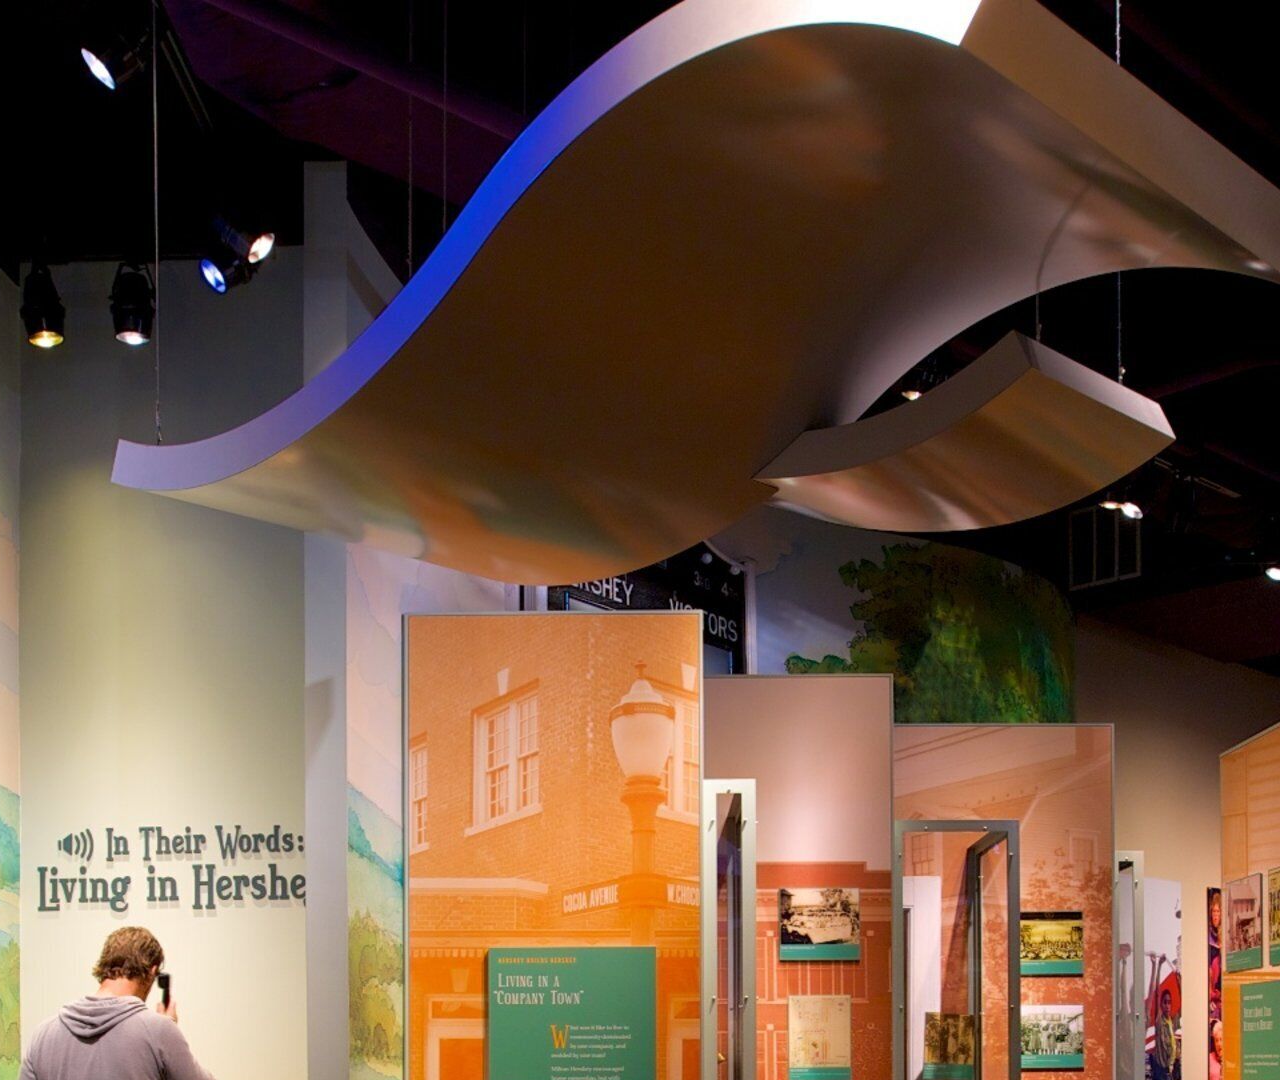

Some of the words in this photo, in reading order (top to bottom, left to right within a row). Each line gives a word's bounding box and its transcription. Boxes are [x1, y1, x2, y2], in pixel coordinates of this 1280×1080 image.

[572, 576, 634, 606] SHEY
[106, 827, 130, 862] In
[139, 826, 207, 861] Their
[215, 824, 305, 860] Words:
[37, 866, 132, 913] Living
[146, 865, 180, 902] in
[192, 863, 306, 911] Hershe
